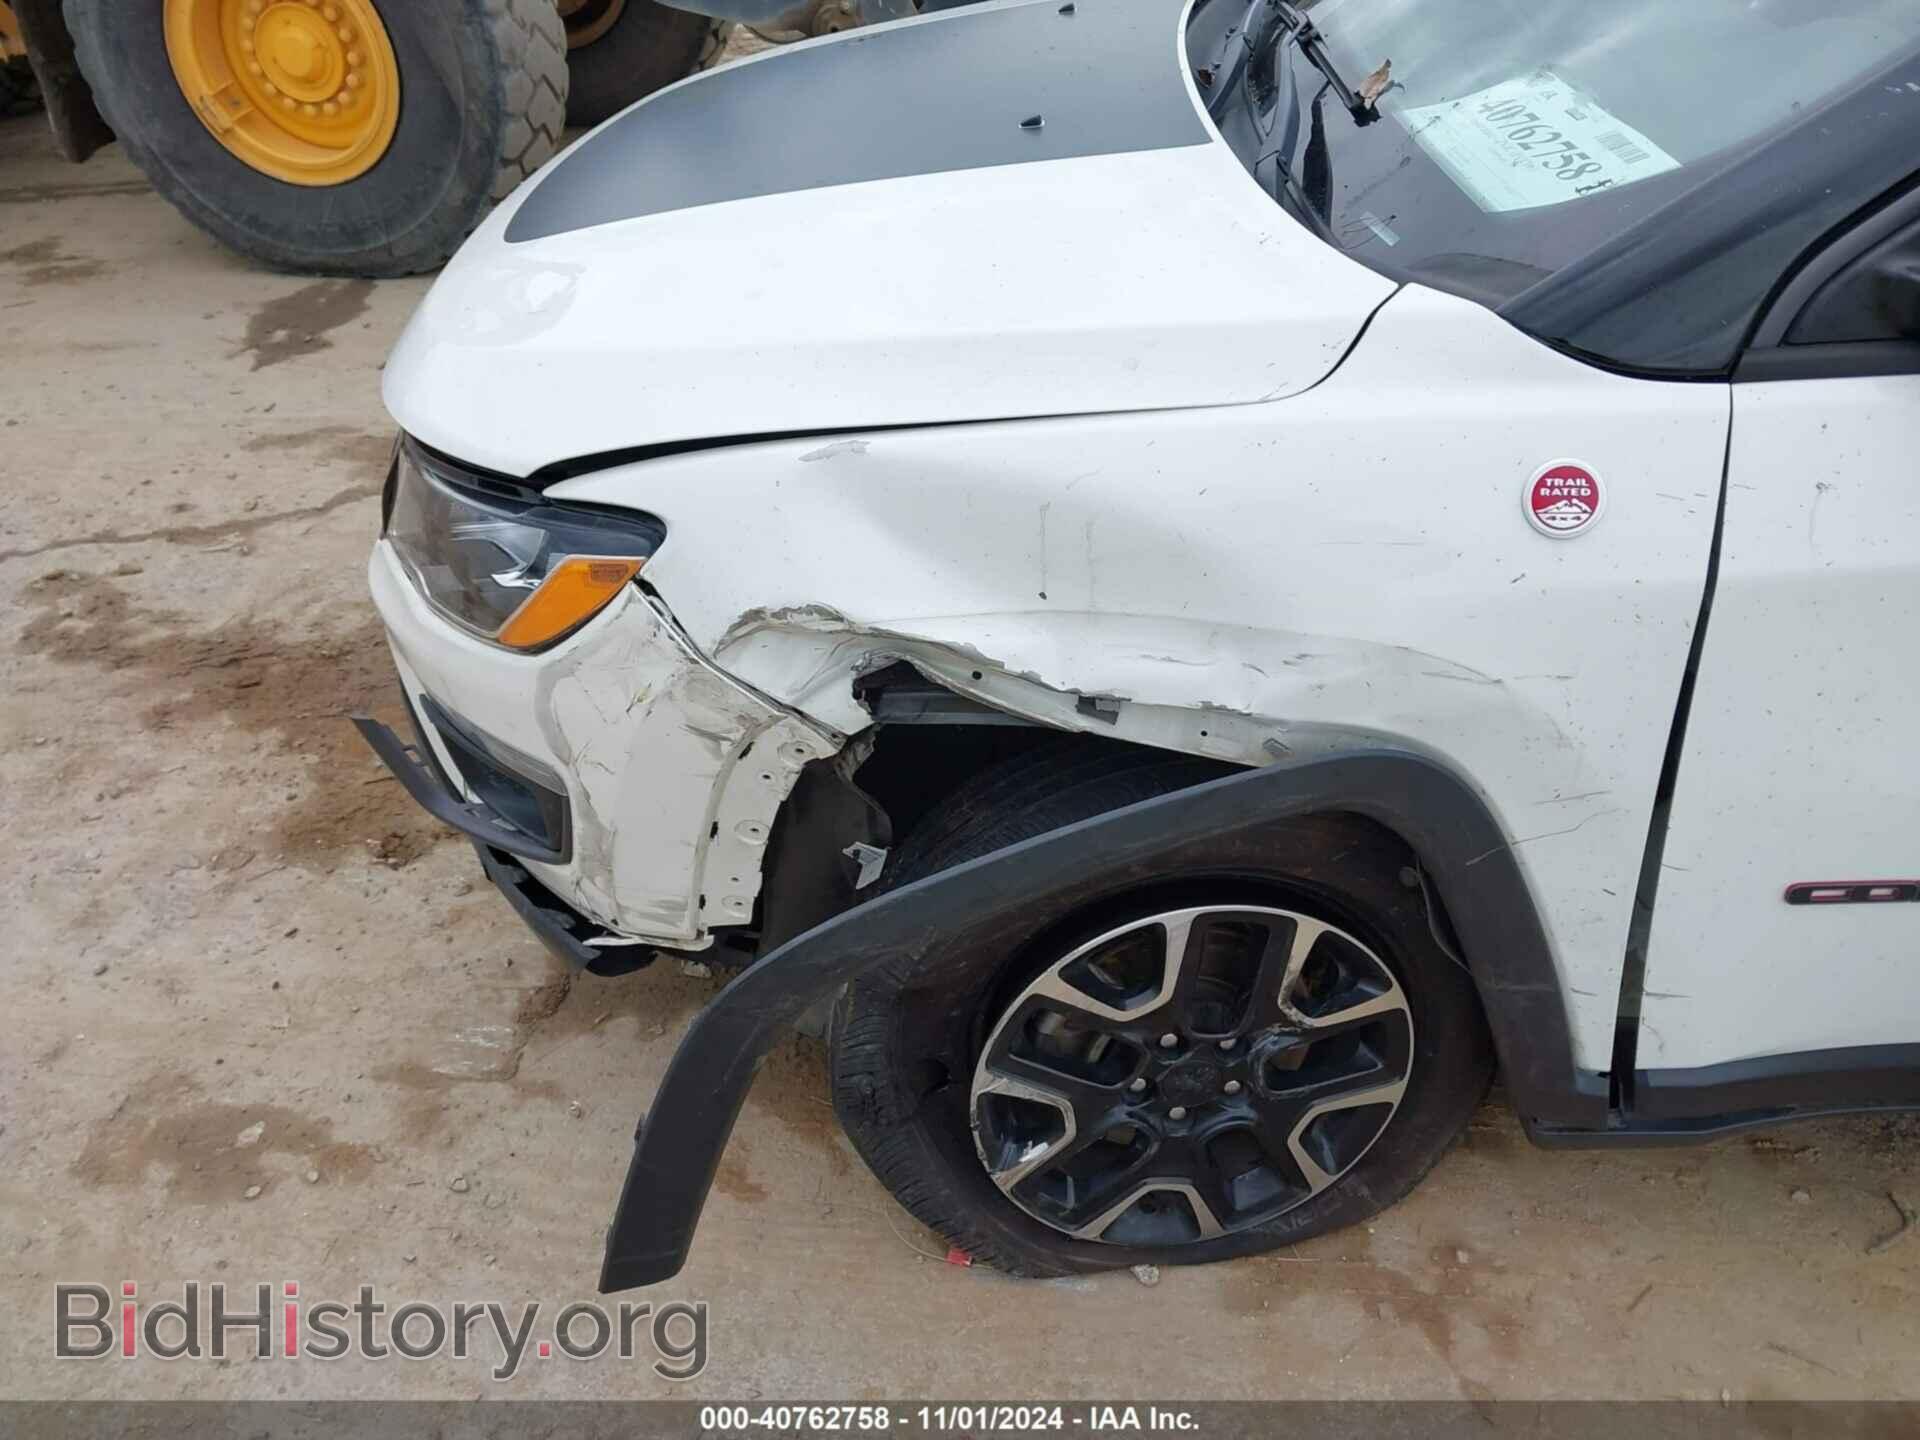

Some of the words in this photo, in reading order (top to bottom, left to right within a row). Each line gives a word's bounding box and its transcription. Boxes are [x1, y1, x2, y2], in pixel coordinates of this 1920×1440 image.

[1476, 96, 1602, 181] 40762758
[1545, 478, 1589, 486] TRAIL
[1540, 488, 1591, 496] RATED
